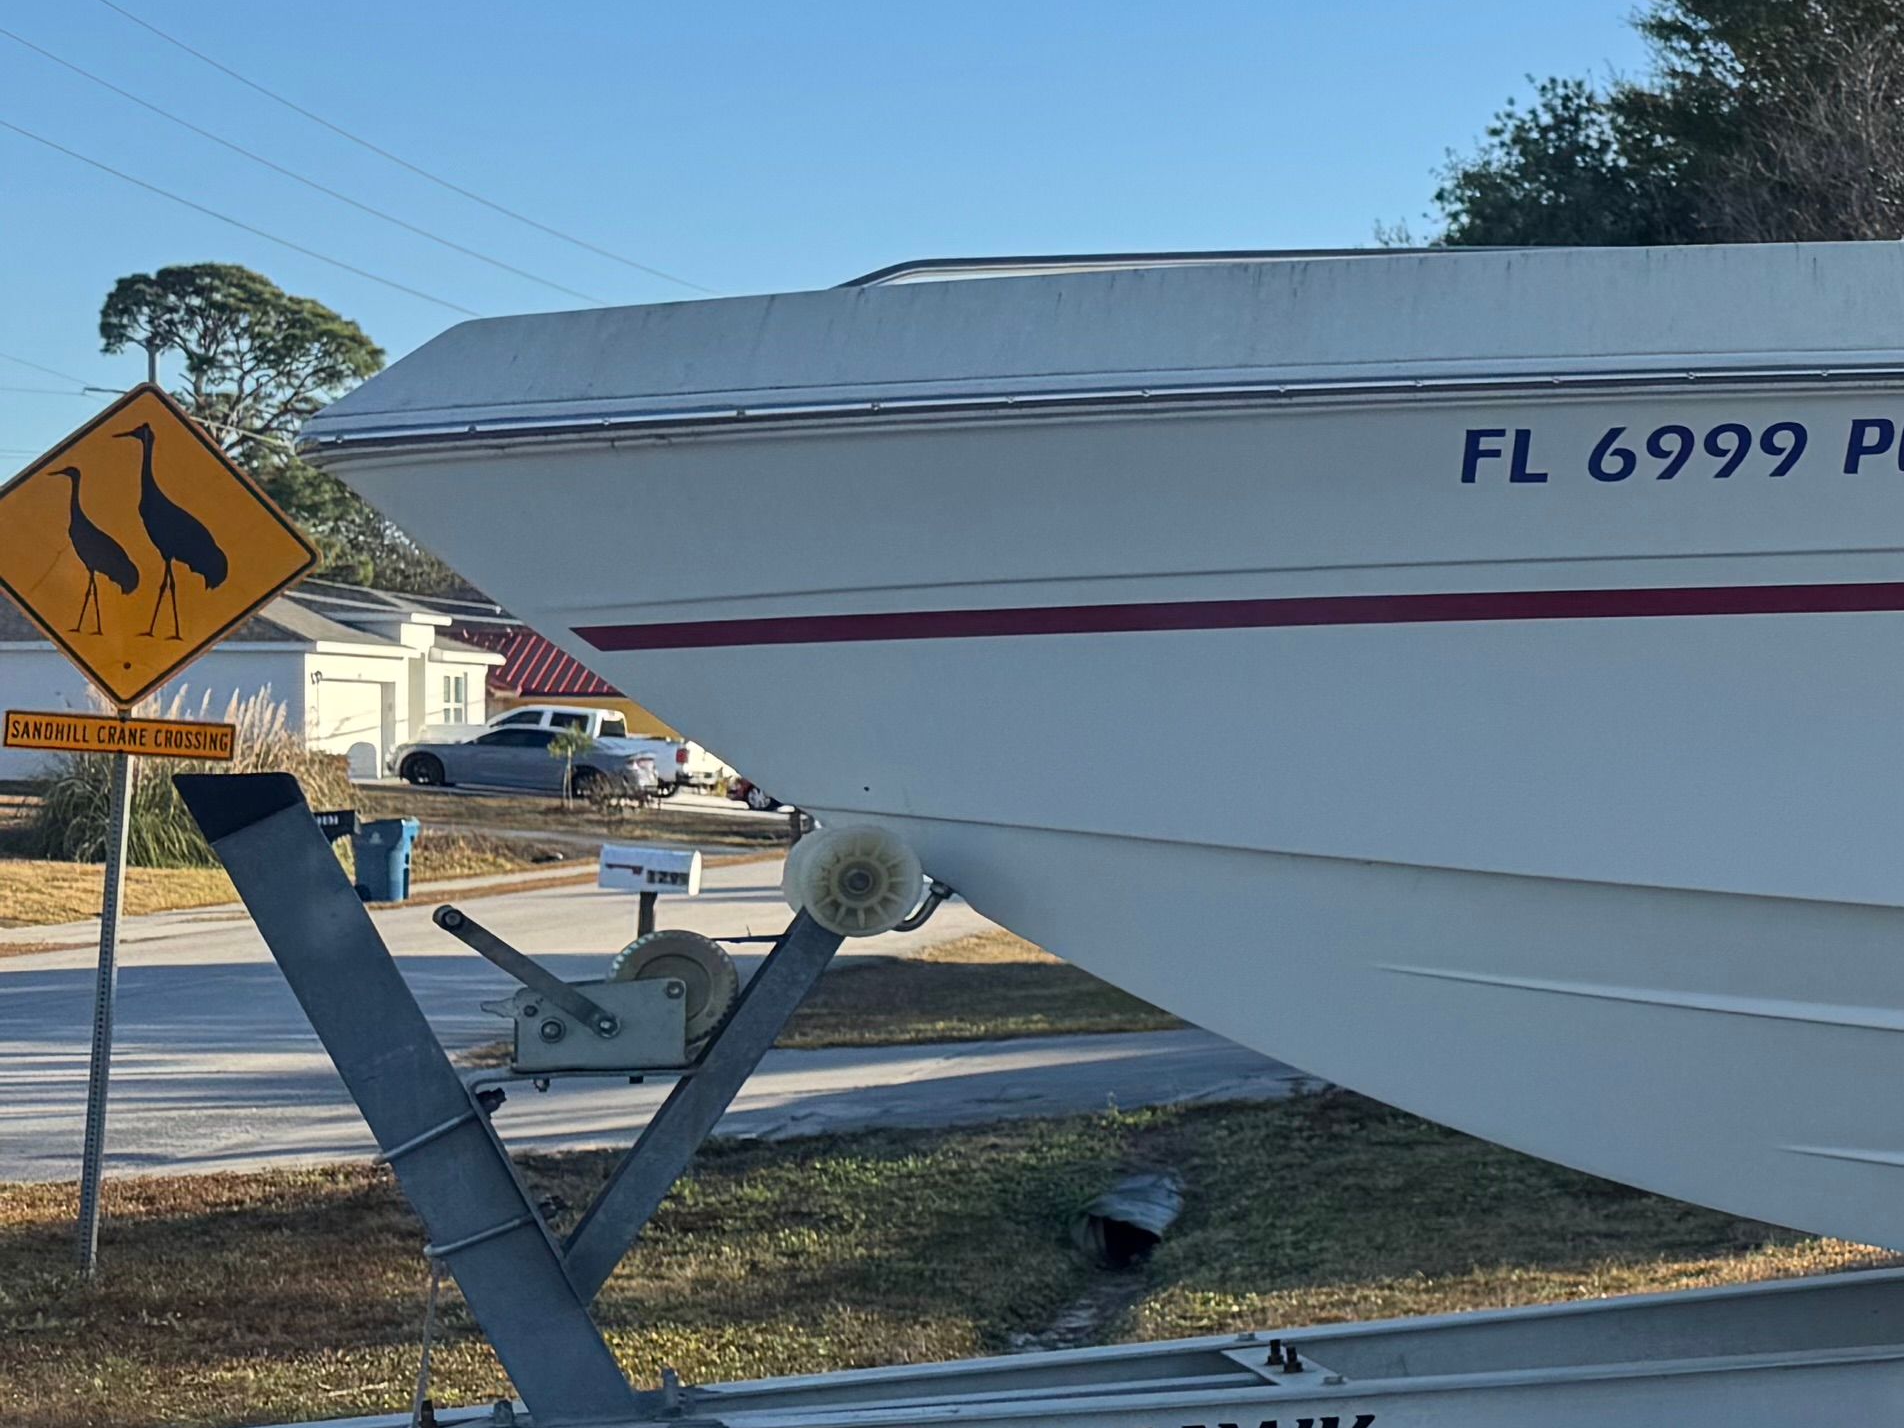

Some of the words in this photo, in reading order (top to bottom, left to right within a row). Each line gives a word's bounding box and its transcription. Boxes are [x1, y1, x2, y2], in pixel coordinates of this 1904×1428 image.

[1461, 428, 1549, 483] FL
[1587, 421, 1808, 482] 6999
[11, 720, 90, 743] SANDHILL
[97, 725, 147, 746] CRANE
[154, 729, 229, 751] CROSSING
